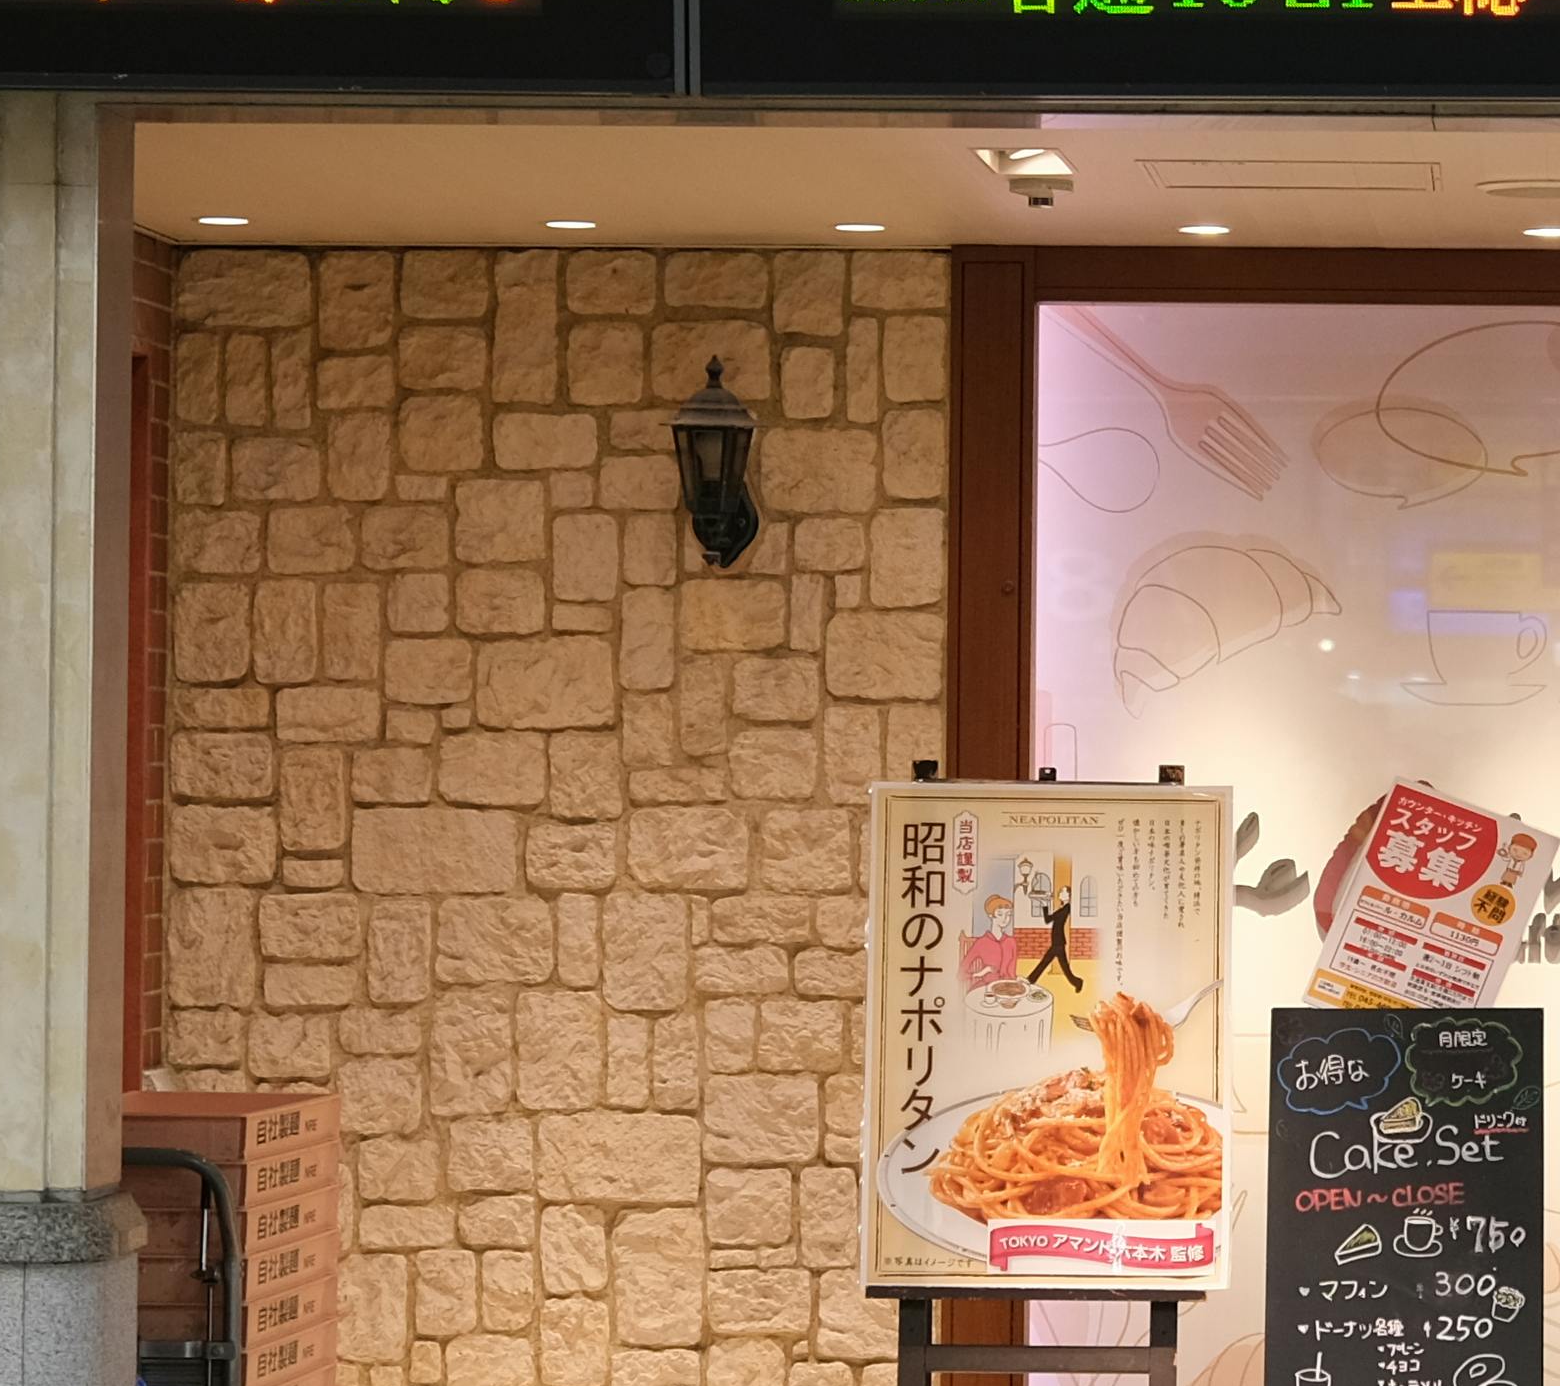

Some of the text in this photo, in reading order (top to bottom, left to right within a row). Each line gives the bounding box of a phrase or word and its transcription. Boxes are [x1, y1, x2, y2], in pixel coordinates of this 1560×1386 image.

[1009, 815, 1099, 826] NEAPOLITAN
[1390, 809, 1477, 851] スタッフ
[1398, 797, 1483, 833] カウンター・キッチン
[955, 819, 975, 885] 当店謹製
[1378, 830, 1465, 891] 募集
[900, 821, 947, 1176] 昭和のナポリタン
[1439, 1029, 1488, 1048] 月限定
[1295, 1054, 1369, 1090] お得な
[1452, 1072, 1487, 1089] ケーキ
[1310, 1131, 1417, 1179] Cake
[999, 1235, 1205, 1263] TOKYO 監修
[1319, 1280, 1388, 1302] マフィン
[1315, 1318, 1405, 1341] ドーナツ各種
[1386, 1359, 1420, 1375] チョコ
